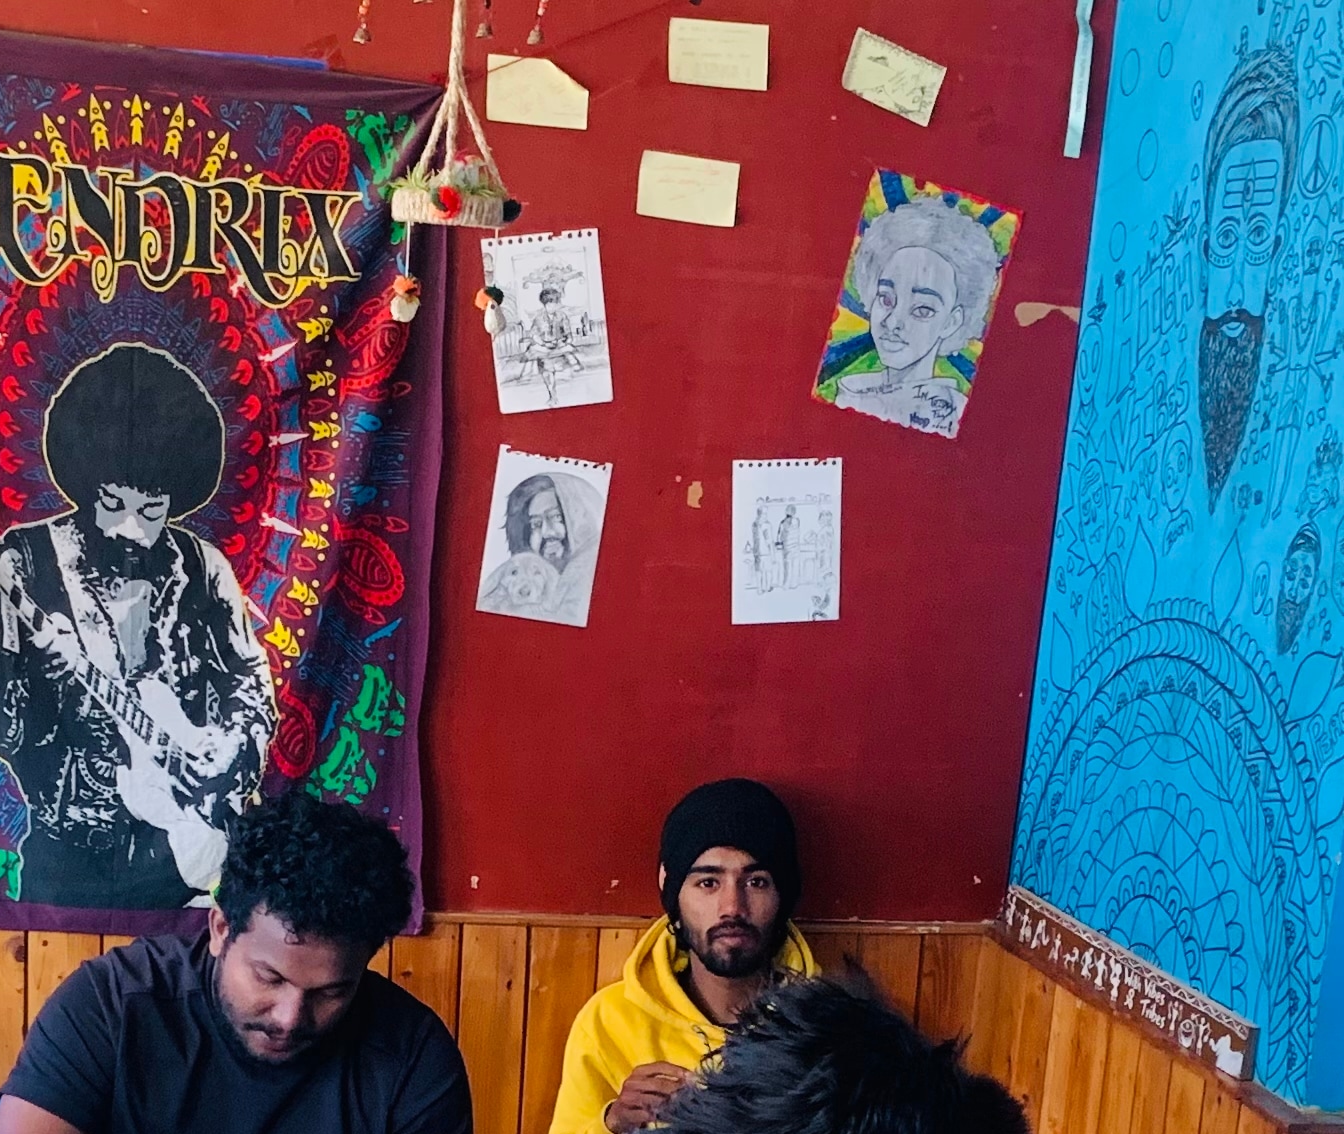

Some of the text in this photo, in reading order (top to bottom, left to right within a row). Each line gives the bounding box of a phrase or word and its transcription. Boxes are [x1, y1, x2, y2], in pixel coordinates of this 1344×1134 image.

[1105, 250, 1194, 408] HIGH
[1110, 358, 1190, 473] VIBES
[1139, 999, 1166, 1029] Tribes
[1144, 978, 1166, 1006] Vibes
